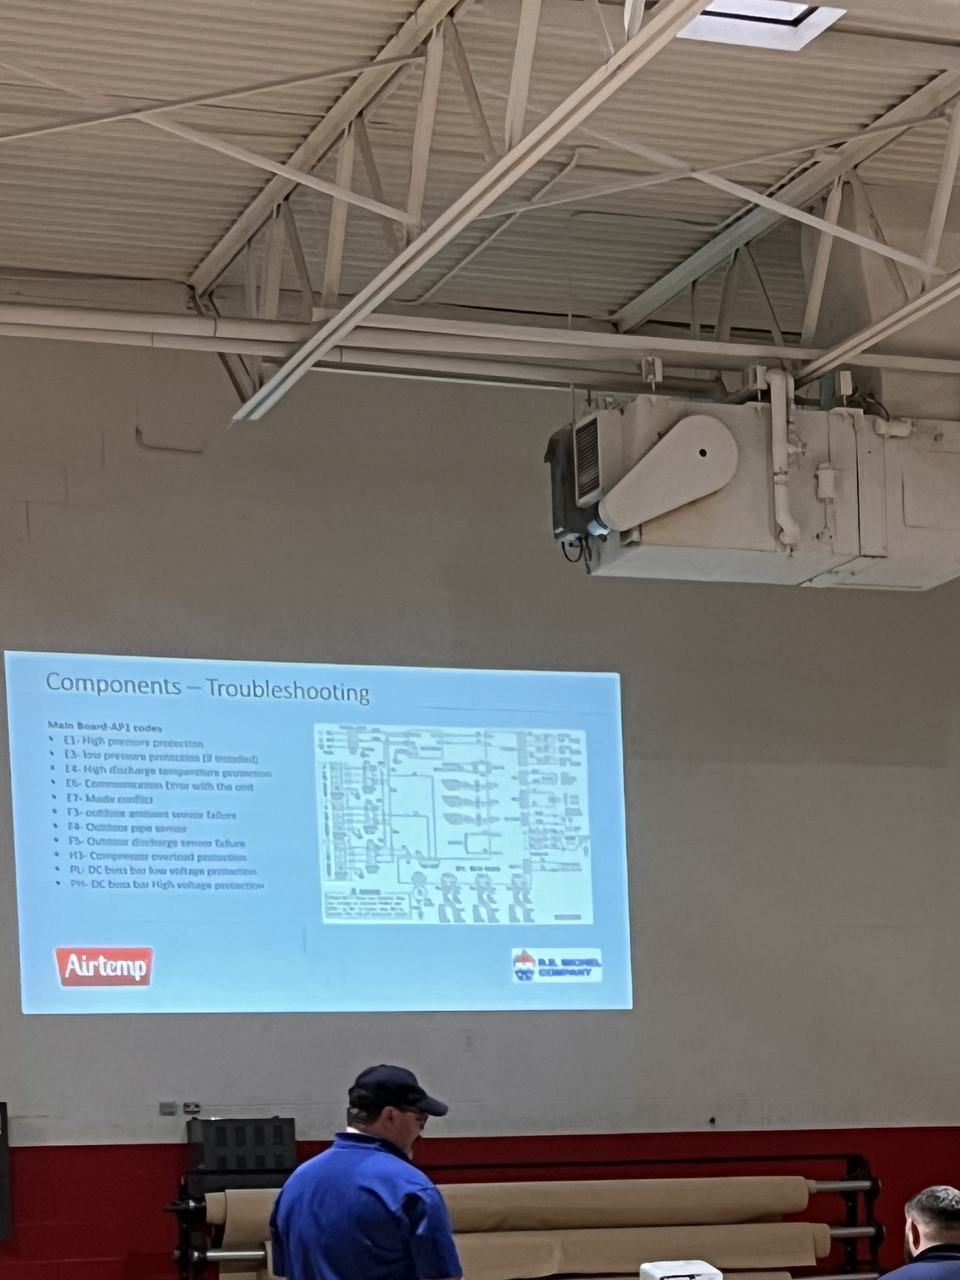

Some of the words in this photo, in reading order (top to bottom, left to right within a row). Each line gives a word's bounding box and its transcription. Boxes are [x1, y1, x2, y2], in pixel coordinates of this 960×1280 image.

[46, 672, 182, 697] Components
[205, 677, 370, 706] Troubleshooting
[65, 953, 147, 981] Airtemp
